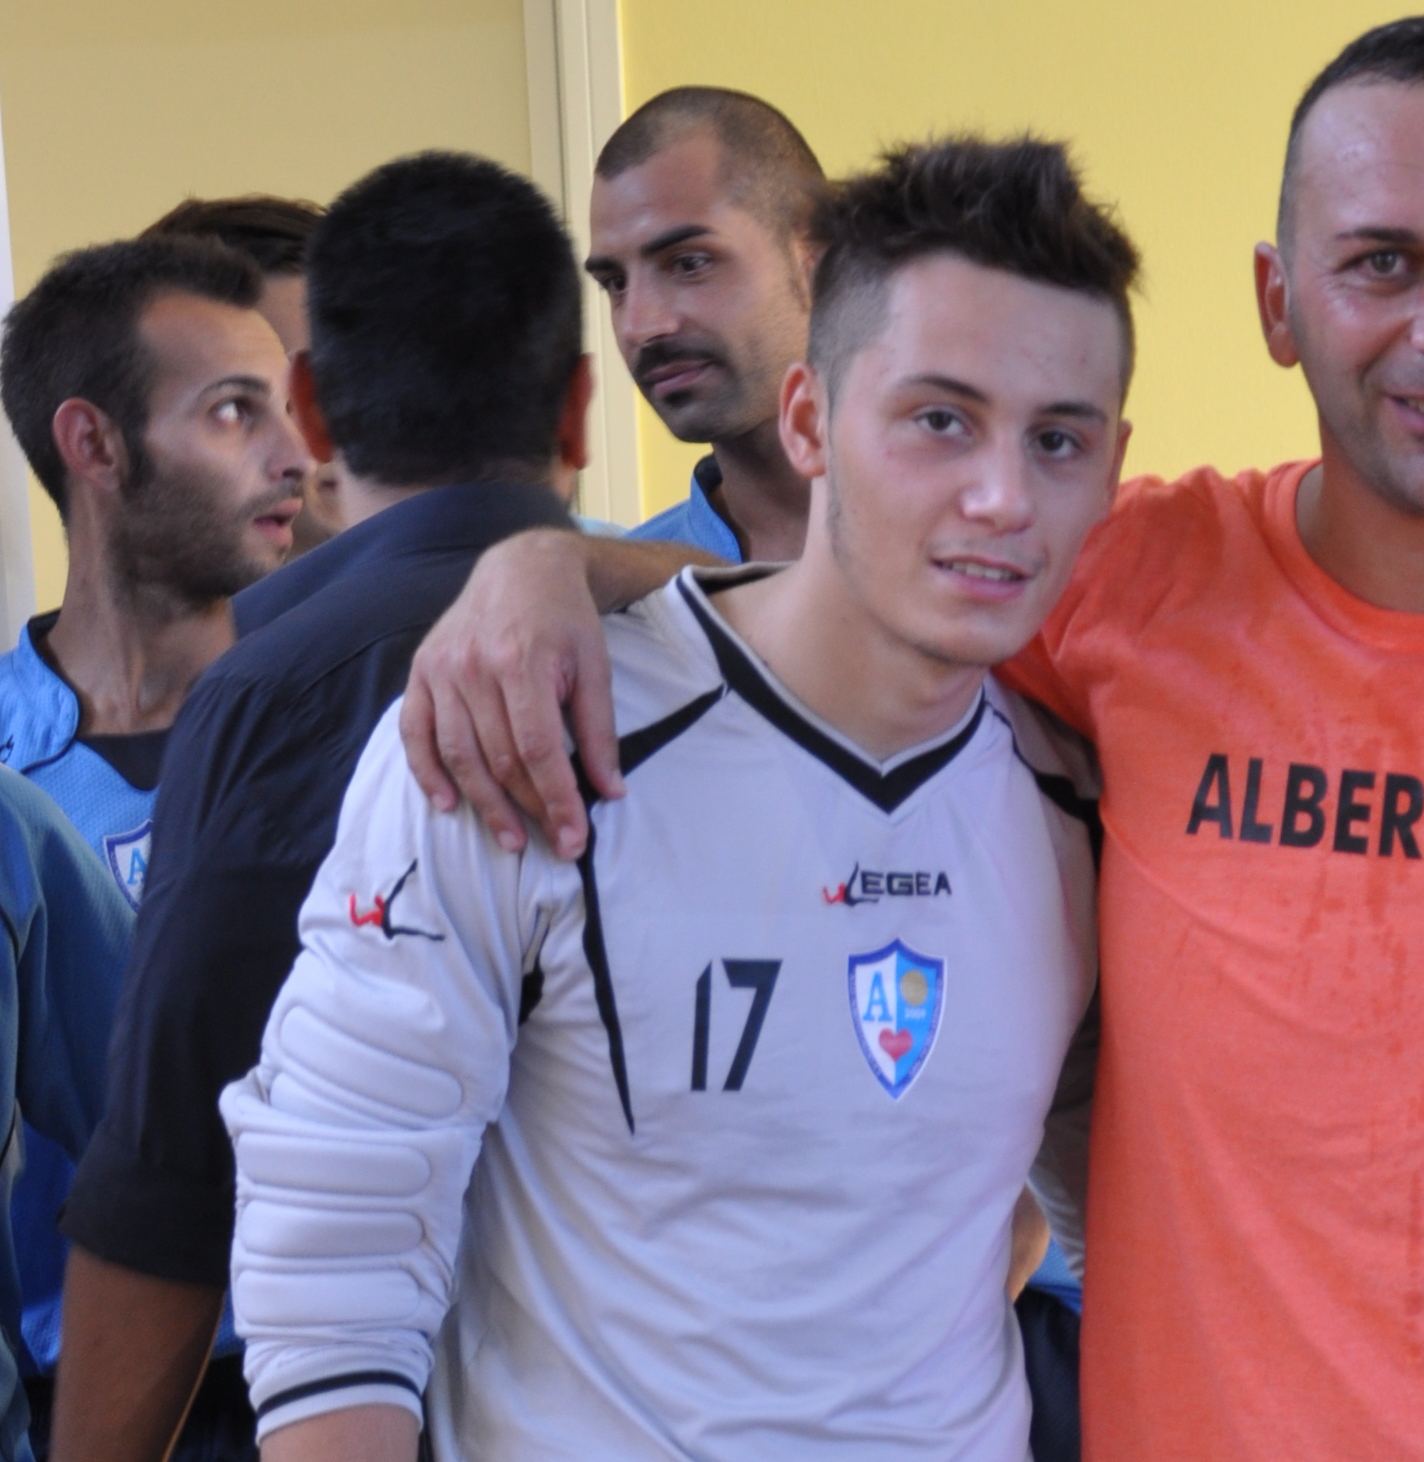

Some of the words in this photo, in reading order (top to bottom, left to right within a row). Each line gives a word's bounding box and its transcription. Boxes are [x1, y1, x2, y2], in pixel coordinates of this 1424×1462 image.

[842, 861, 953, 906] LEGEA
[862, 970, 893, 1022] A
[690, 957, 784, 1092] 17
